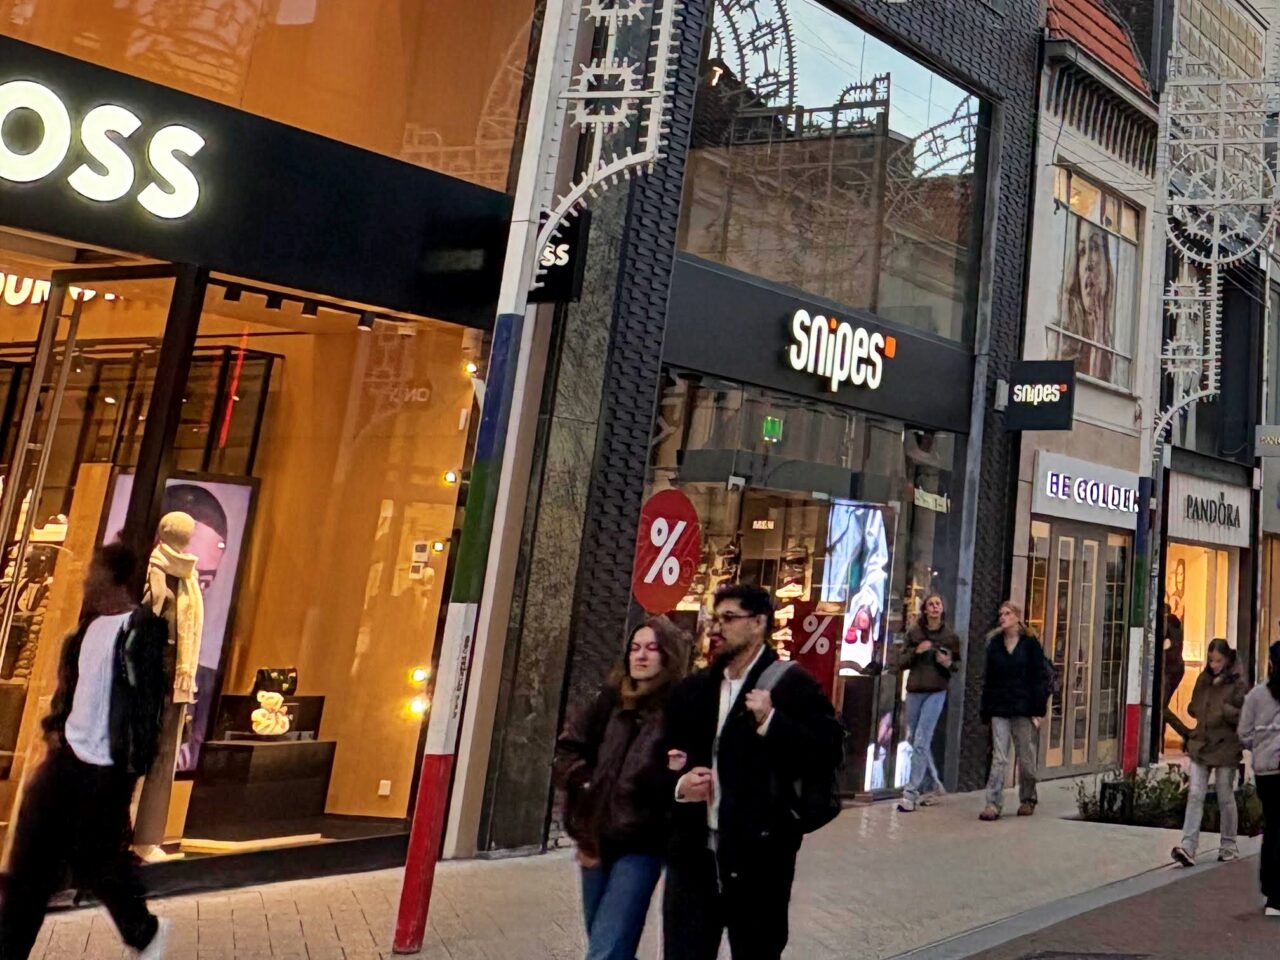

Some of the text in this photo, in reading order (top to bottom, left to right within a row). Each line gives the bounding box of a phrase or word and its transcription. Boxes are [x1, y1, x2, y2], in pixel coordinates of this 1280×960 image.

[789, 307, 884, 392] snipes
[1013, 383, 1060, 405] snipes
[1046, 471, 1071, 500] BE
[1185, 492, 1241, 529] PANDORA
